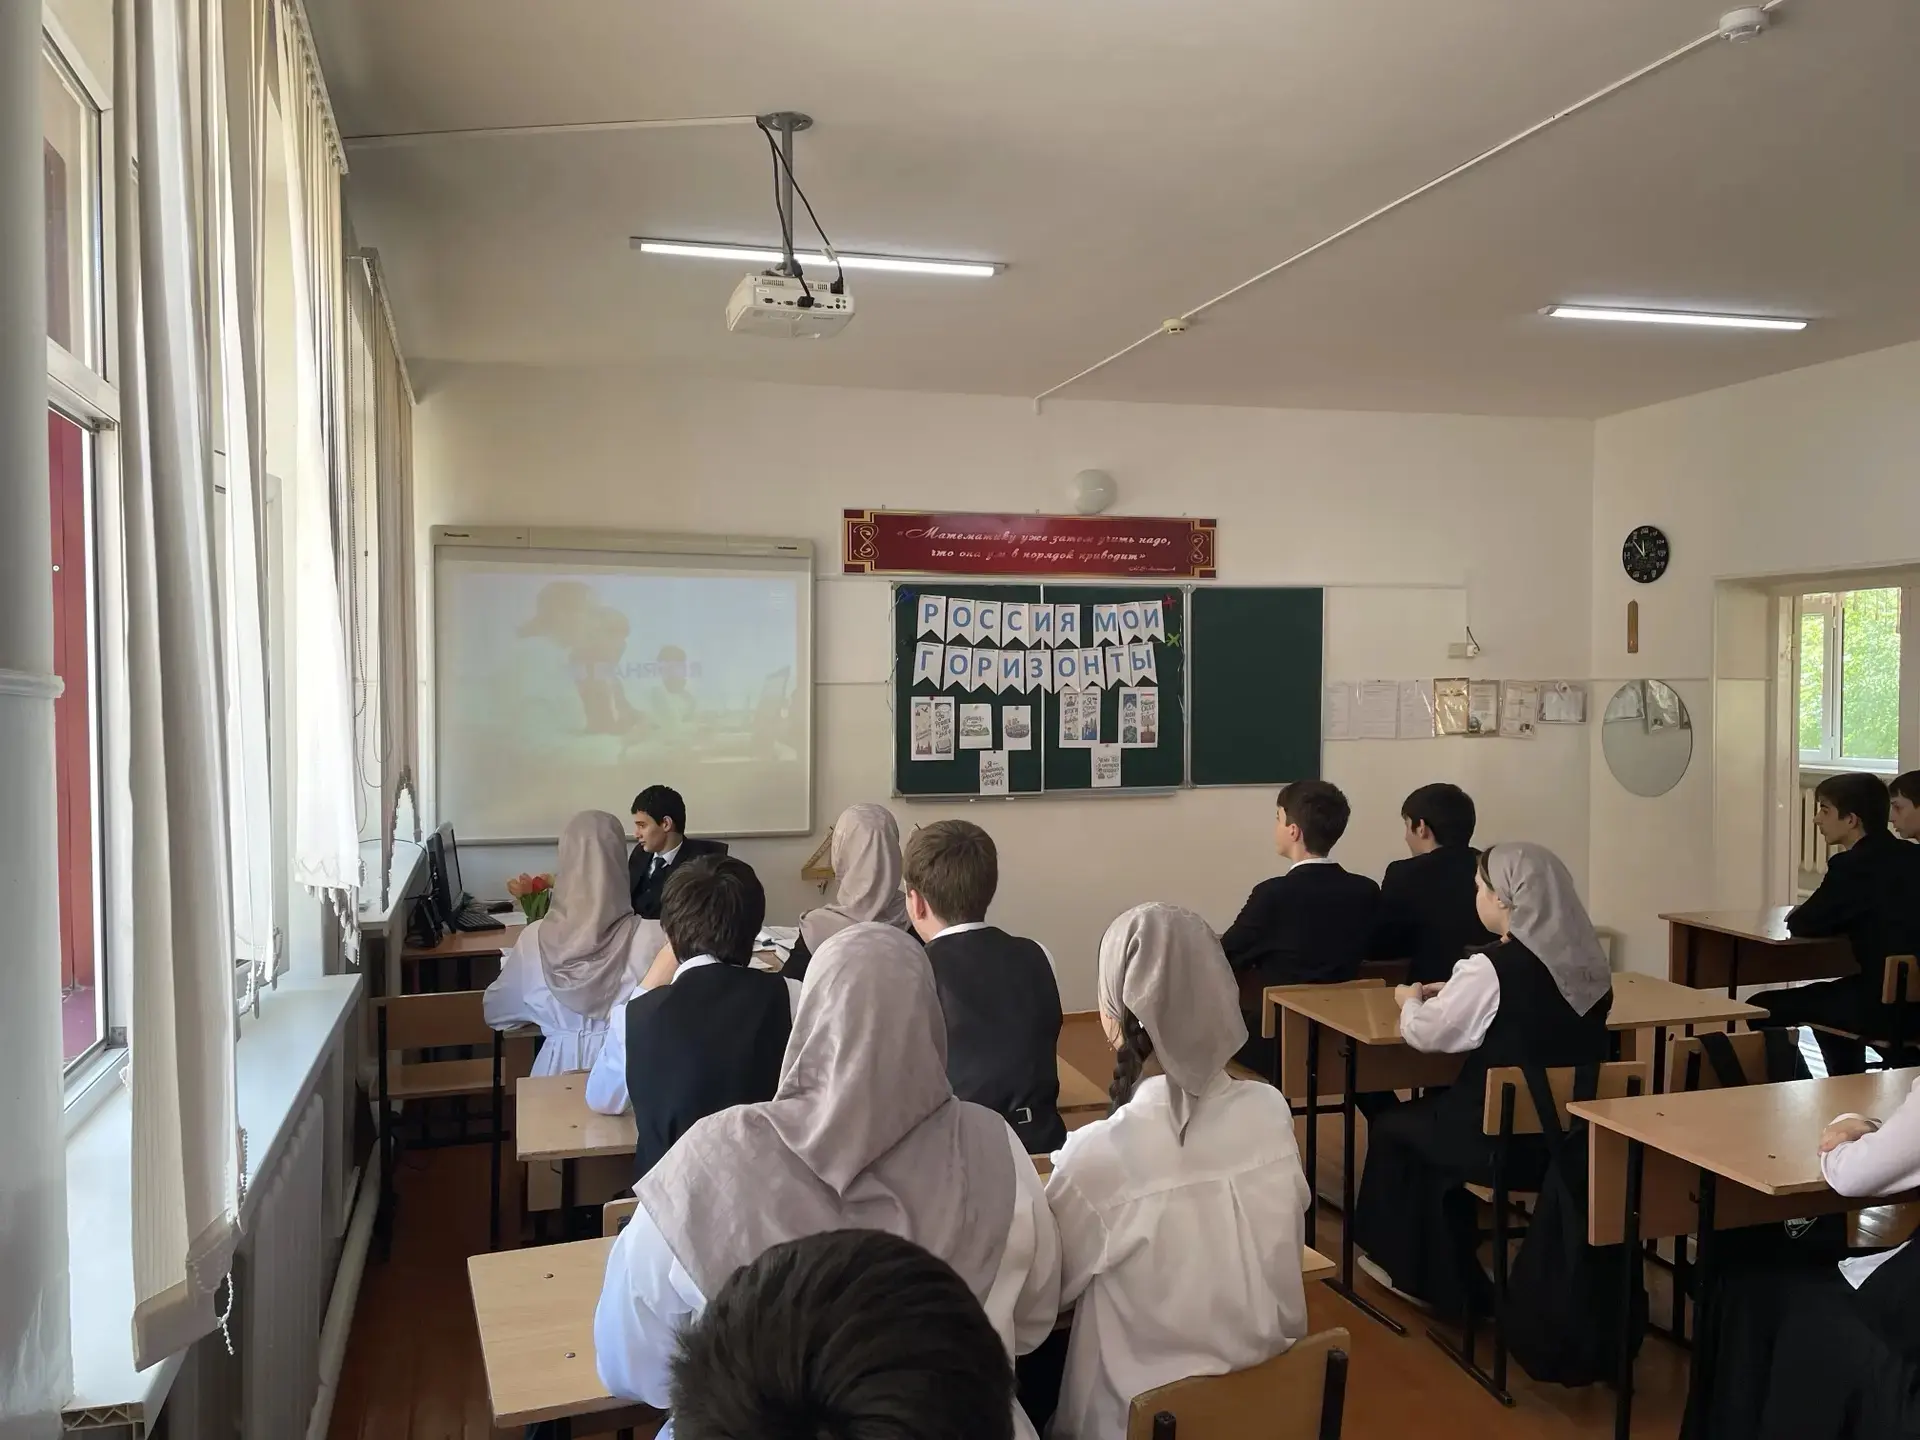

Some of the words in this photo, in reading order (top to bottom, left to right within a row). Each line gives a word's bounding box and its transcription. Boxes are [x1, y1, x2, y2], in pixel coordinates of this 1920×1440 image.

[1020, 532, 1048, 545] уже
[1139, 536, 1171, 547] надо,
[931, 548, 955, 557] что
[959, 550, 981, 558] она
[1011, 547, 1020, 557] в
[1022, 548, 1075, 562] порядок
[1079, 549, 1146, 562] приводит»
[923, 603, 1075, 633] РОССИЯ
[1094, 607, 1160, 633] МОИ
[919, 649, 1151, 679] ГОРИЗОНТЫ
